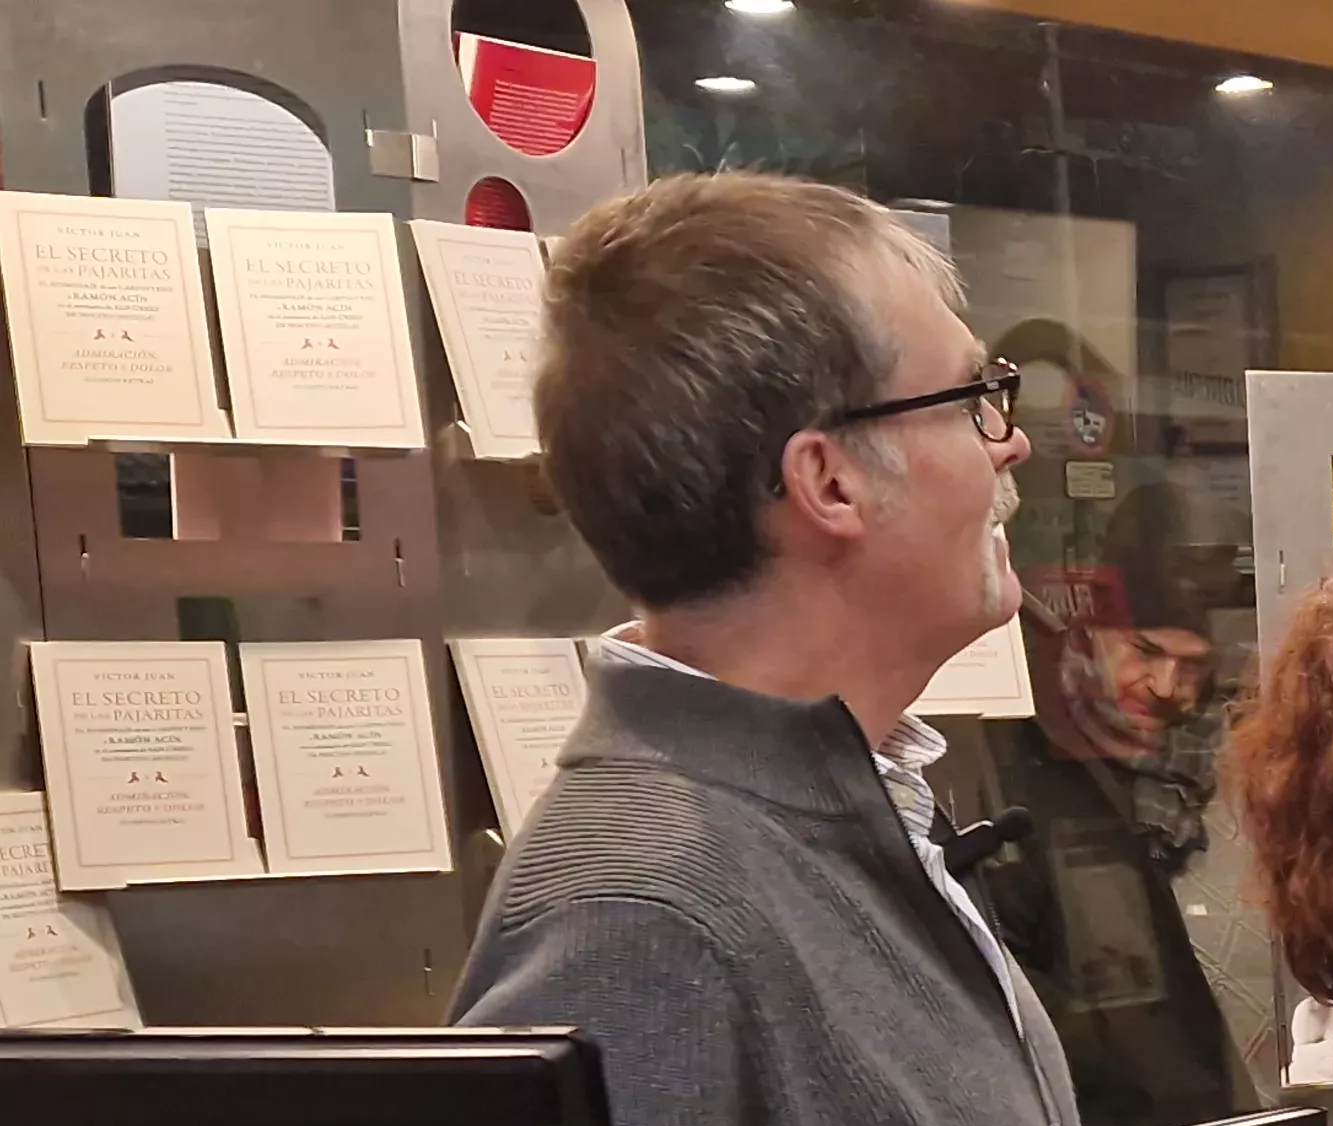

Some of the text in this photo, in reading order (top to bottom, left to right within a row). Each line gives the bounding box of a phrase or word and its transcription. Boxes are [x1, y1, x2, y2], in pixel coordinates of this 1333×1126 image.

[35, 244, 168, 266] EL SECRETO
[78, 265, 171, 281] PAJARITAS
[246, 258, 371, 275] EL SECRETO
[286, 277, 374, 291] PAJARITAS
[72, 690, 201, 706] EL SECRETO
[279, 688, 400, 704] EL SECRETO
[113, 708, 204, 723] PAJARITAS
[318, 705, 403, 719] PAJARITAS
